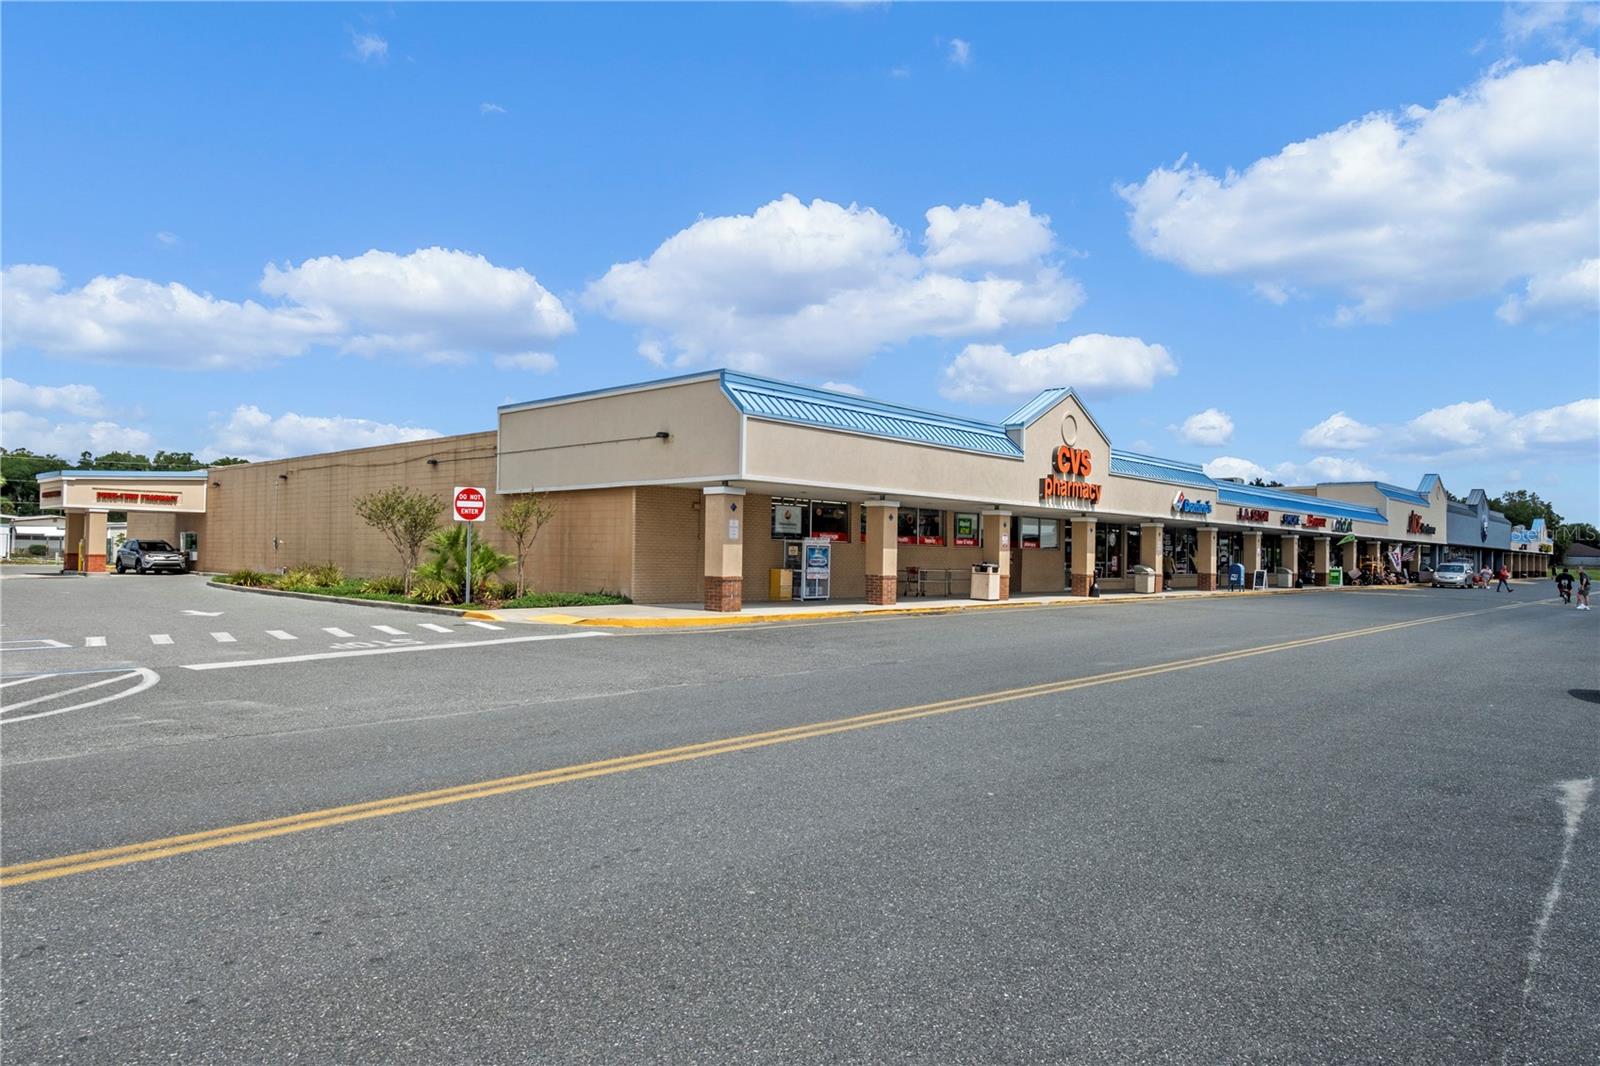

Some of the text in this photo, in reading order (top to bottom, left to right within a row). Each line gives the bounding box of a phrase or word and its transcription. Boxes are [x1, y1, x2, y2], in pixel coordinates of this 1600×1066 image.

[1053, 445, 1092, 477] CVS
[1042, 474, 1102, 504] pharmacy
[1184, 499, 1212, 514] Domino's
